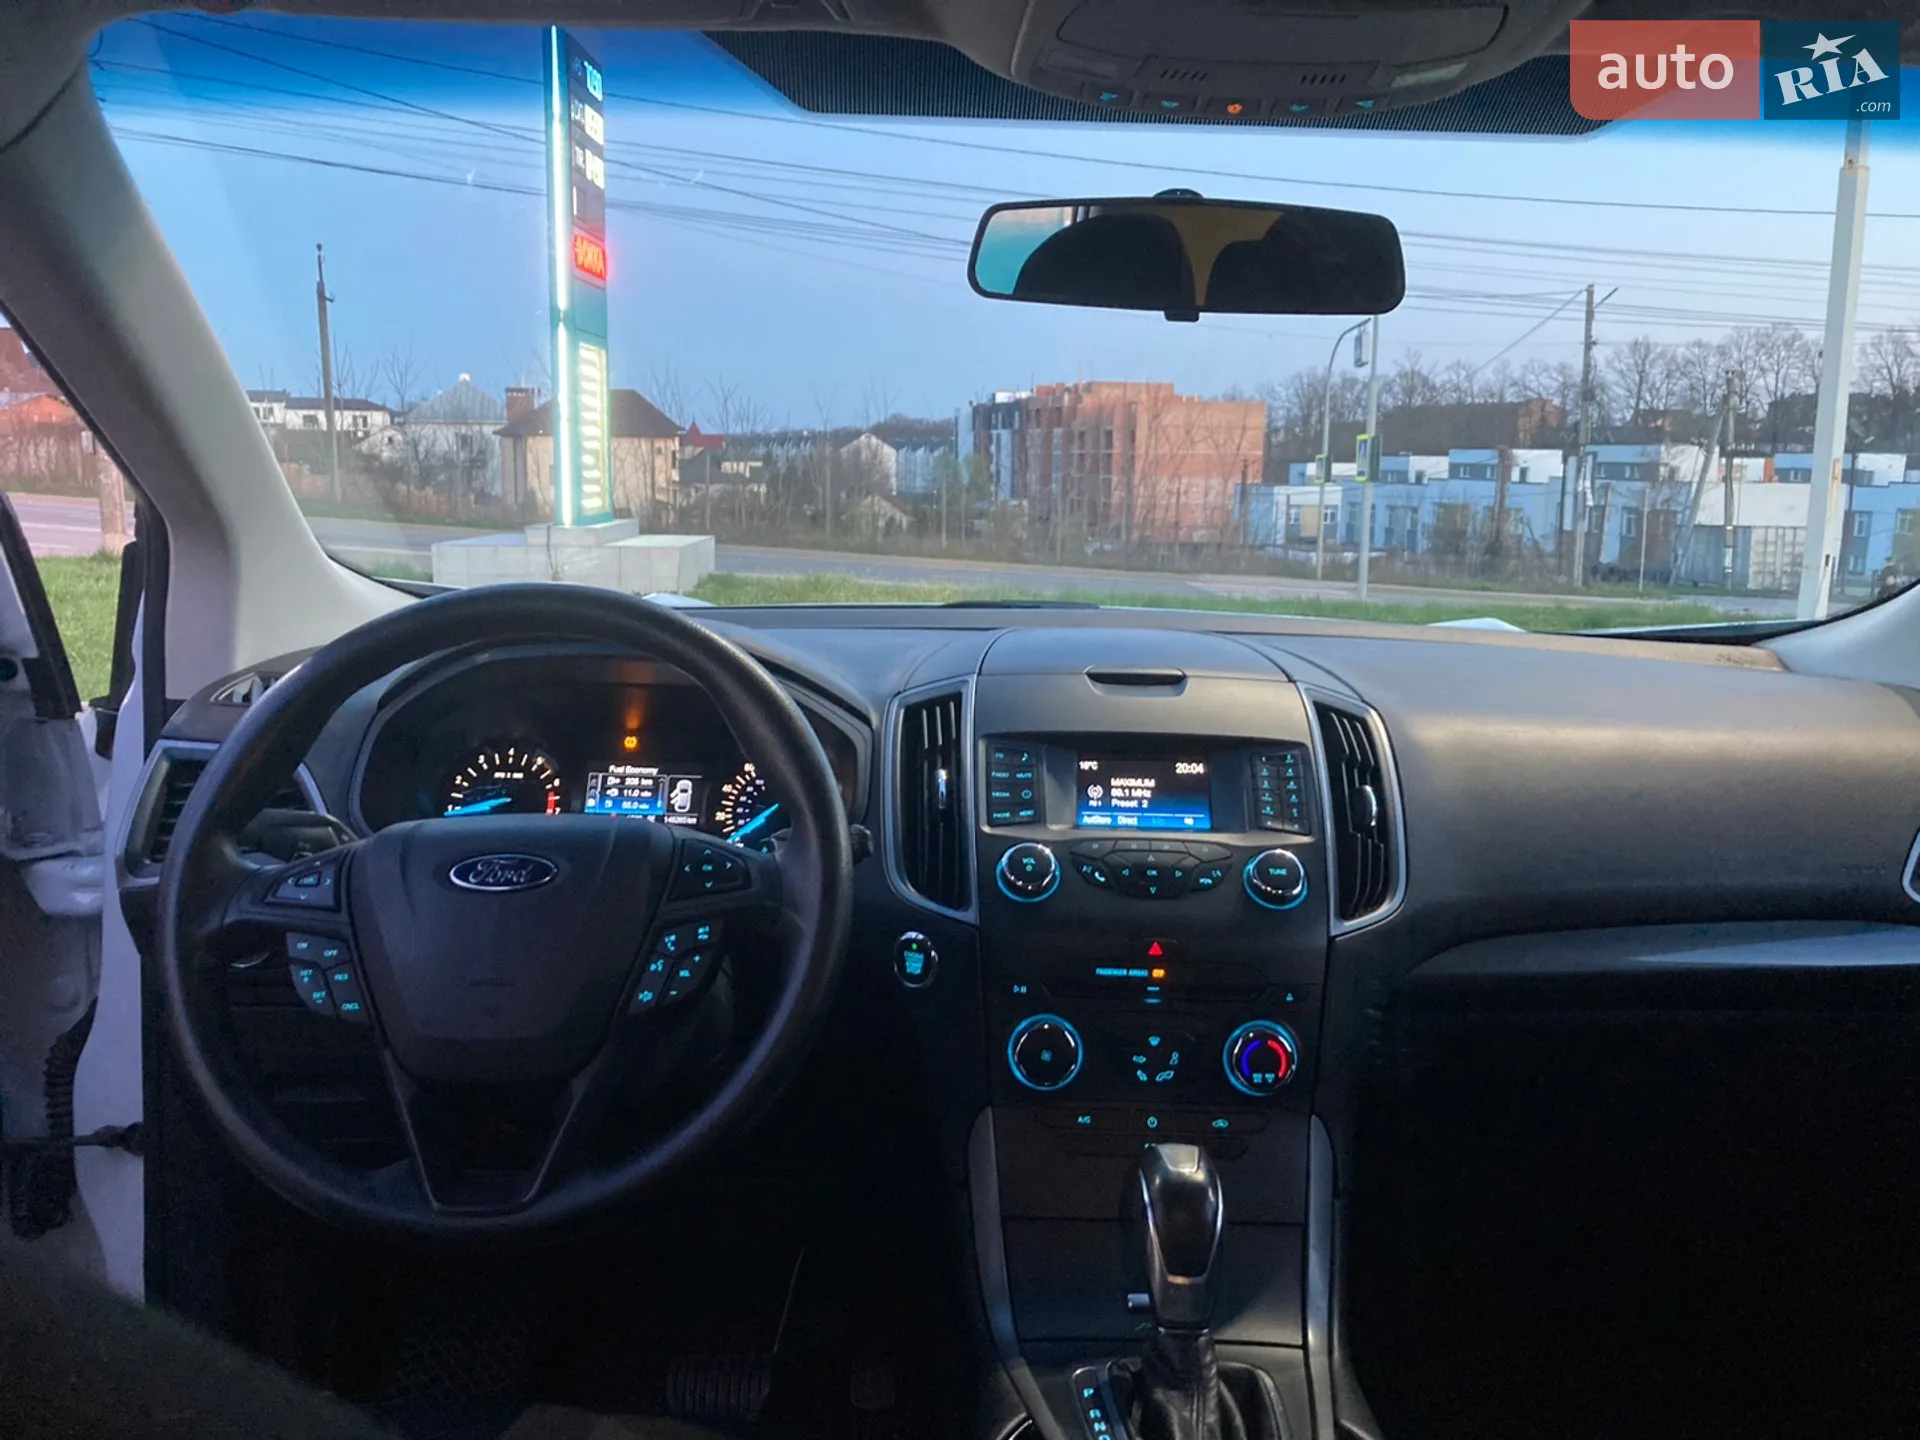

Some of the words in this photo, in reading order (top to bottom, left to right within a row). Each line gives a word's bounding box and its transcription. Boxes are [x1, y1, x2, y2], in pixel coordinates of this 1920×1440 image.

[1175, 762, 1204, 774] 20:04
[1083, 1388, 1094, 1397] P
[1094, 1421, 1107, 1432] N
